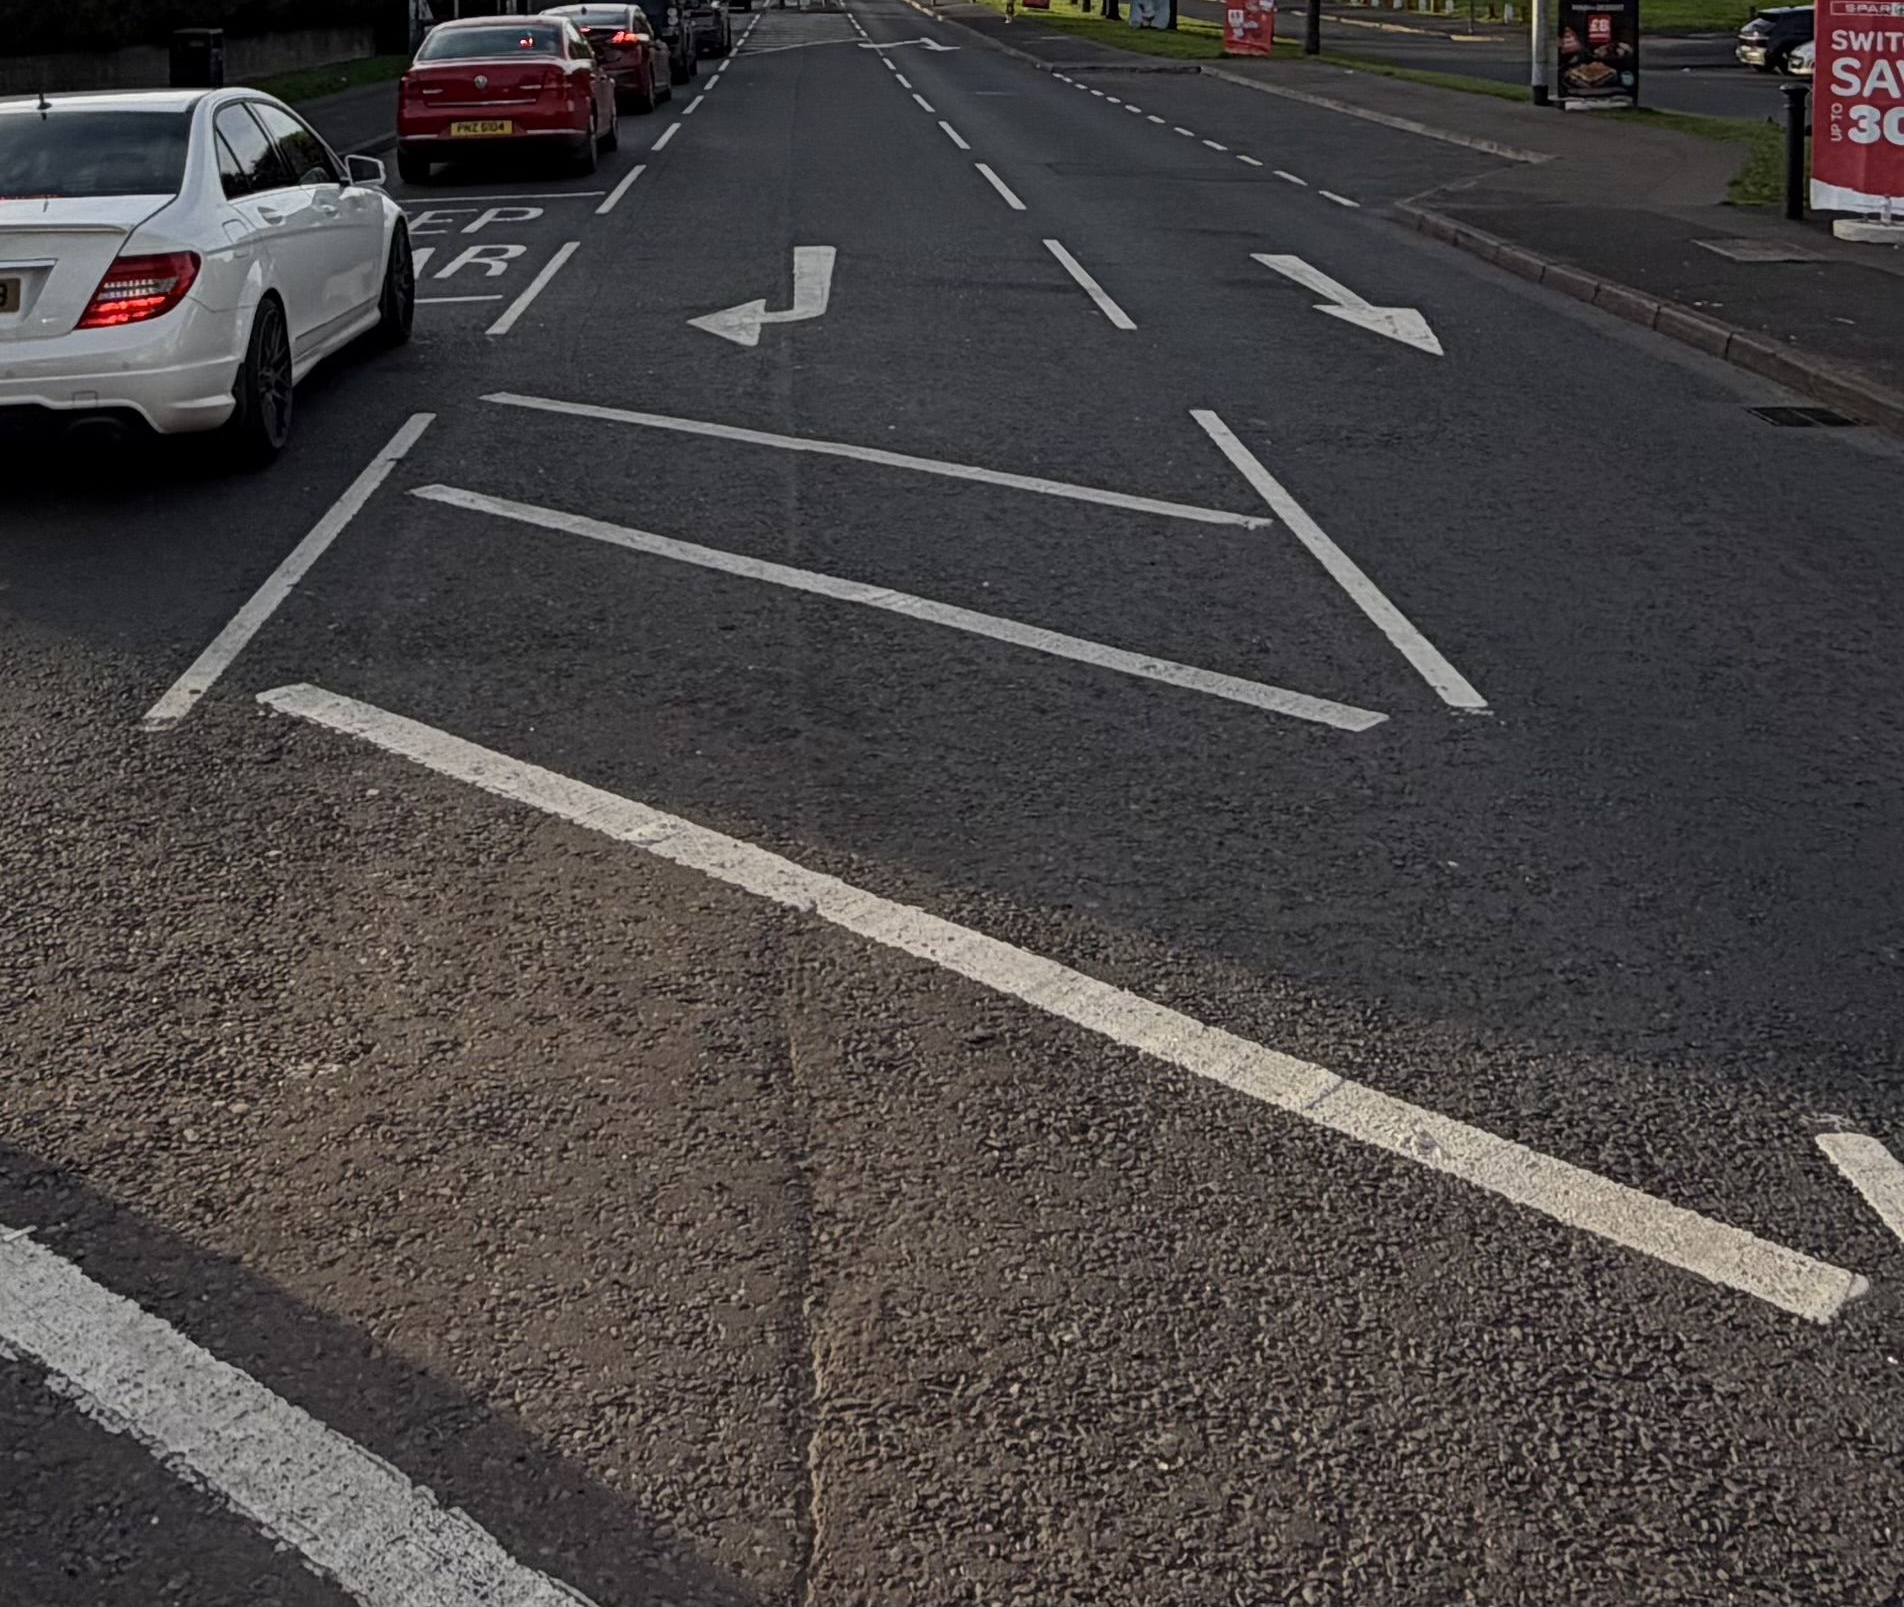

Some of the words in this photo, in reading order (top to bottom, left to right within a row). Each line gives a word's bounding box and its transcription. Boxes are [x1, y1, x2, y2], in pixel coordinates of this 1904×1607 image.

[1845, 3, 1891, 13] SPAR
[1831, 103, 1843, 121] TO
[1830, 123, 1843, 142] UP
